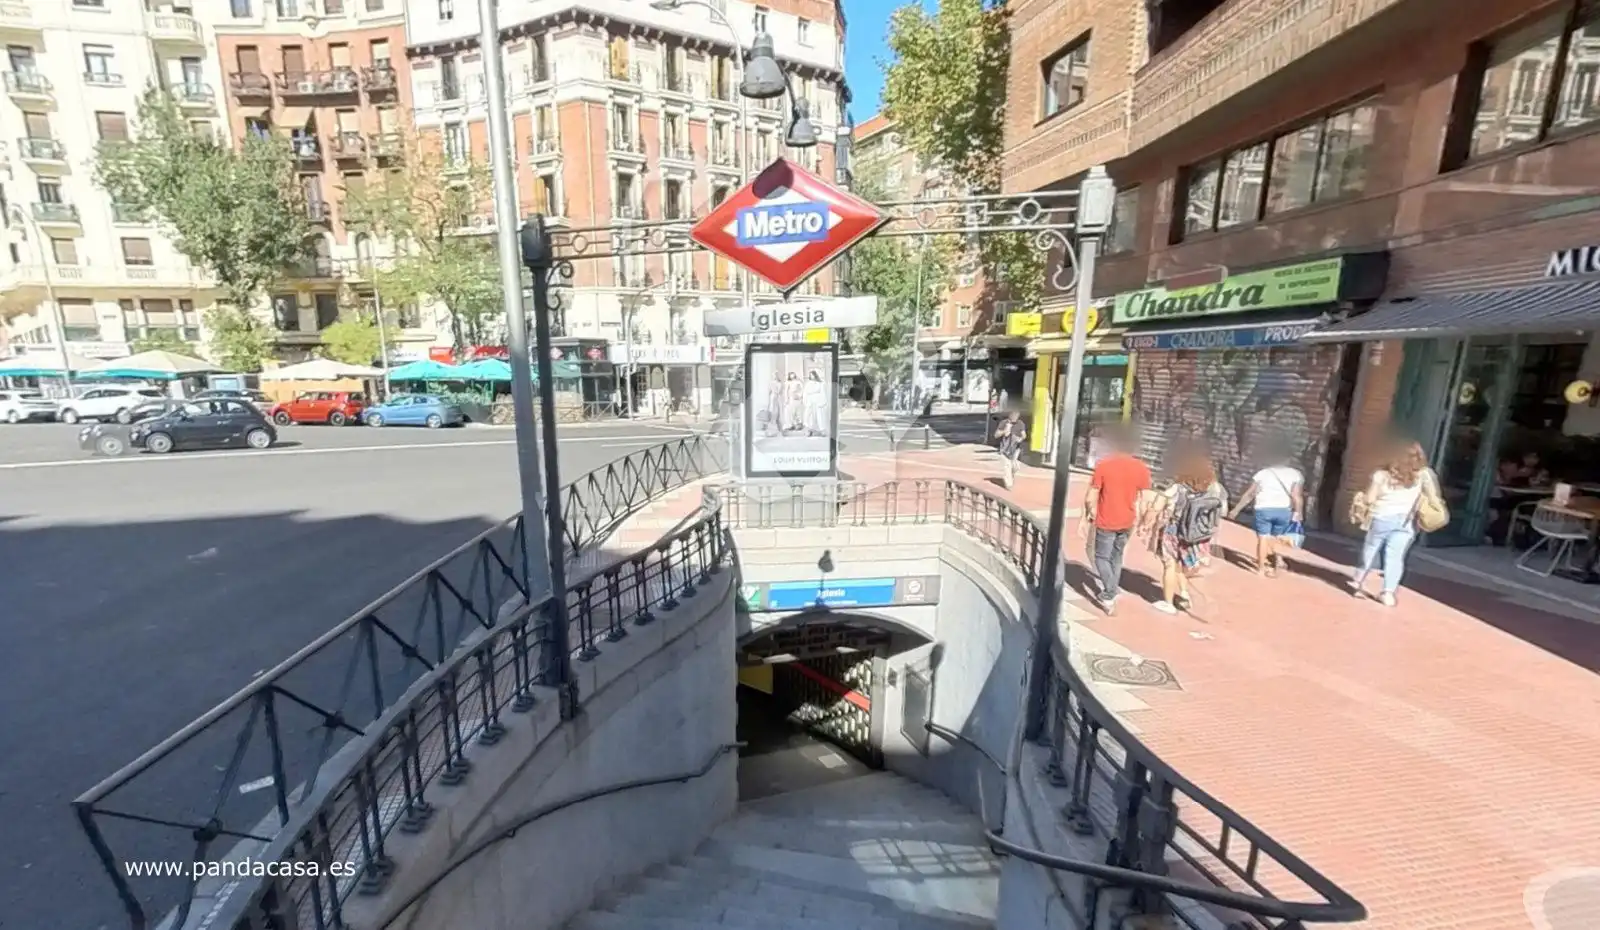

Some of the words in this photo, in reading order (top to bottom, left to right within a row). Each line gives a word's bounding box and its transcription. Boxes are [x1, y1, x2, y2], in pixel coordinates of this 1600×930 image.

[744, 210, 824, 239] Metro
[1124, 282, 1266, 318] Chandra
[1170, 330, 1235, 349] CHANDRA
